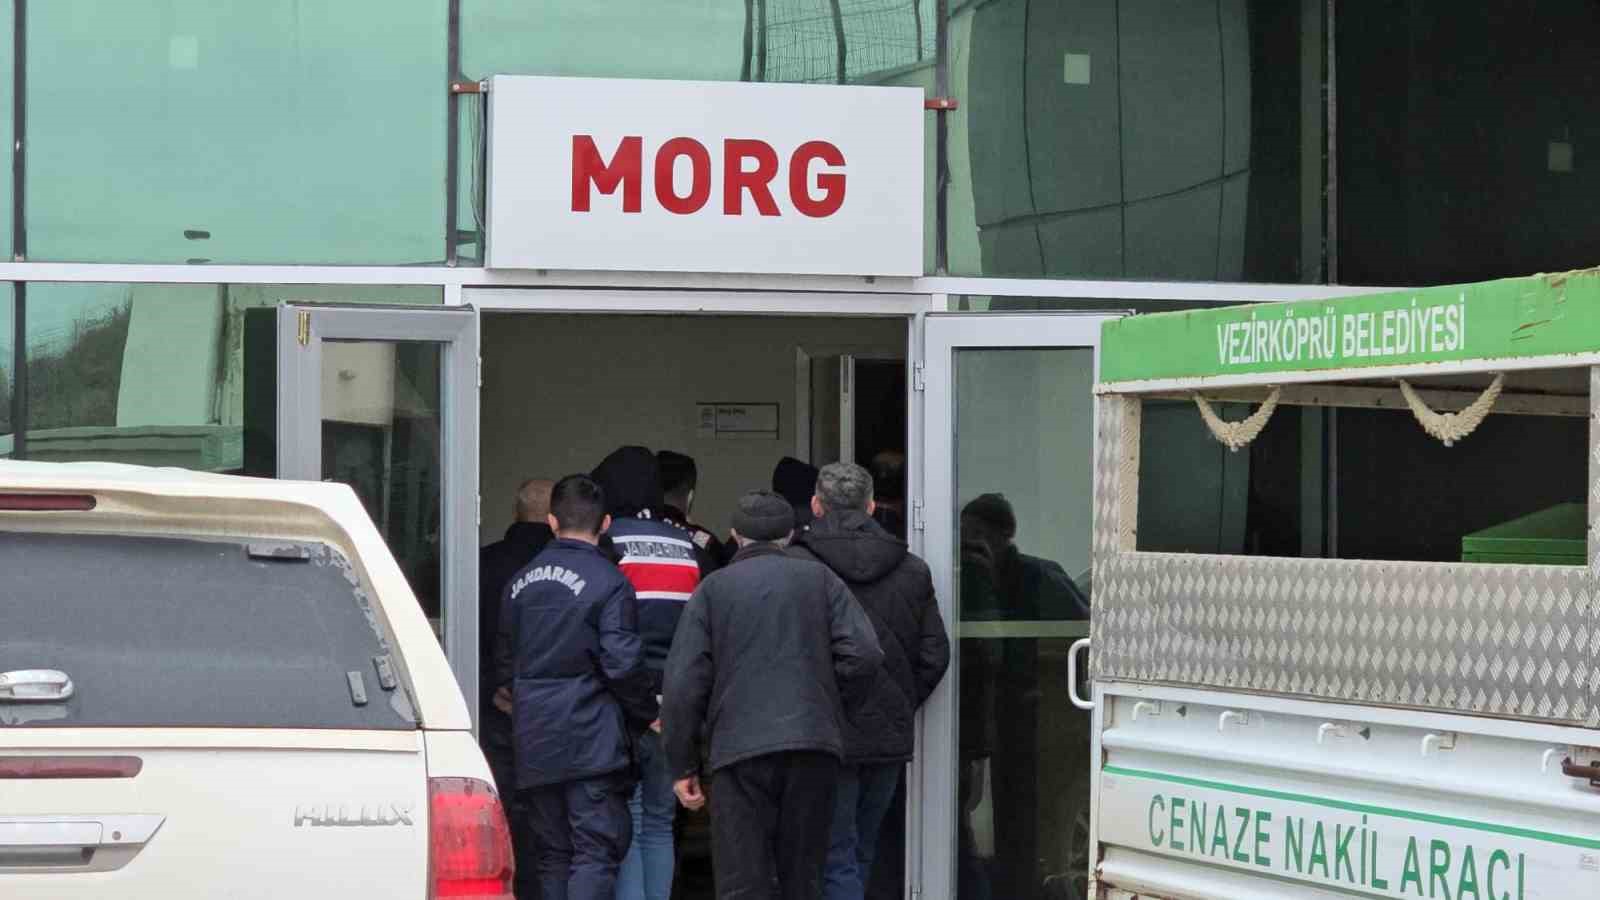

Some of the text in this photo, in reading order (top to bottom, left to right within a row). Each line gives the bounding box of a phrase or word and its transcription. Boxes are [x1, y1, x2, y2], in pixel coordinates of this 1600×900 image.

[571, 135, 847, 218] MORG
[1217, 292, 1465, 365] VEZİRKÖPRÜ BELEDİYESİ
[511, 565, 586, 599] JANDARMA
[294, 802, 413, 827] HILUX
[1147, 794, 1525, 900] CENAZE NAKİL ARACI
